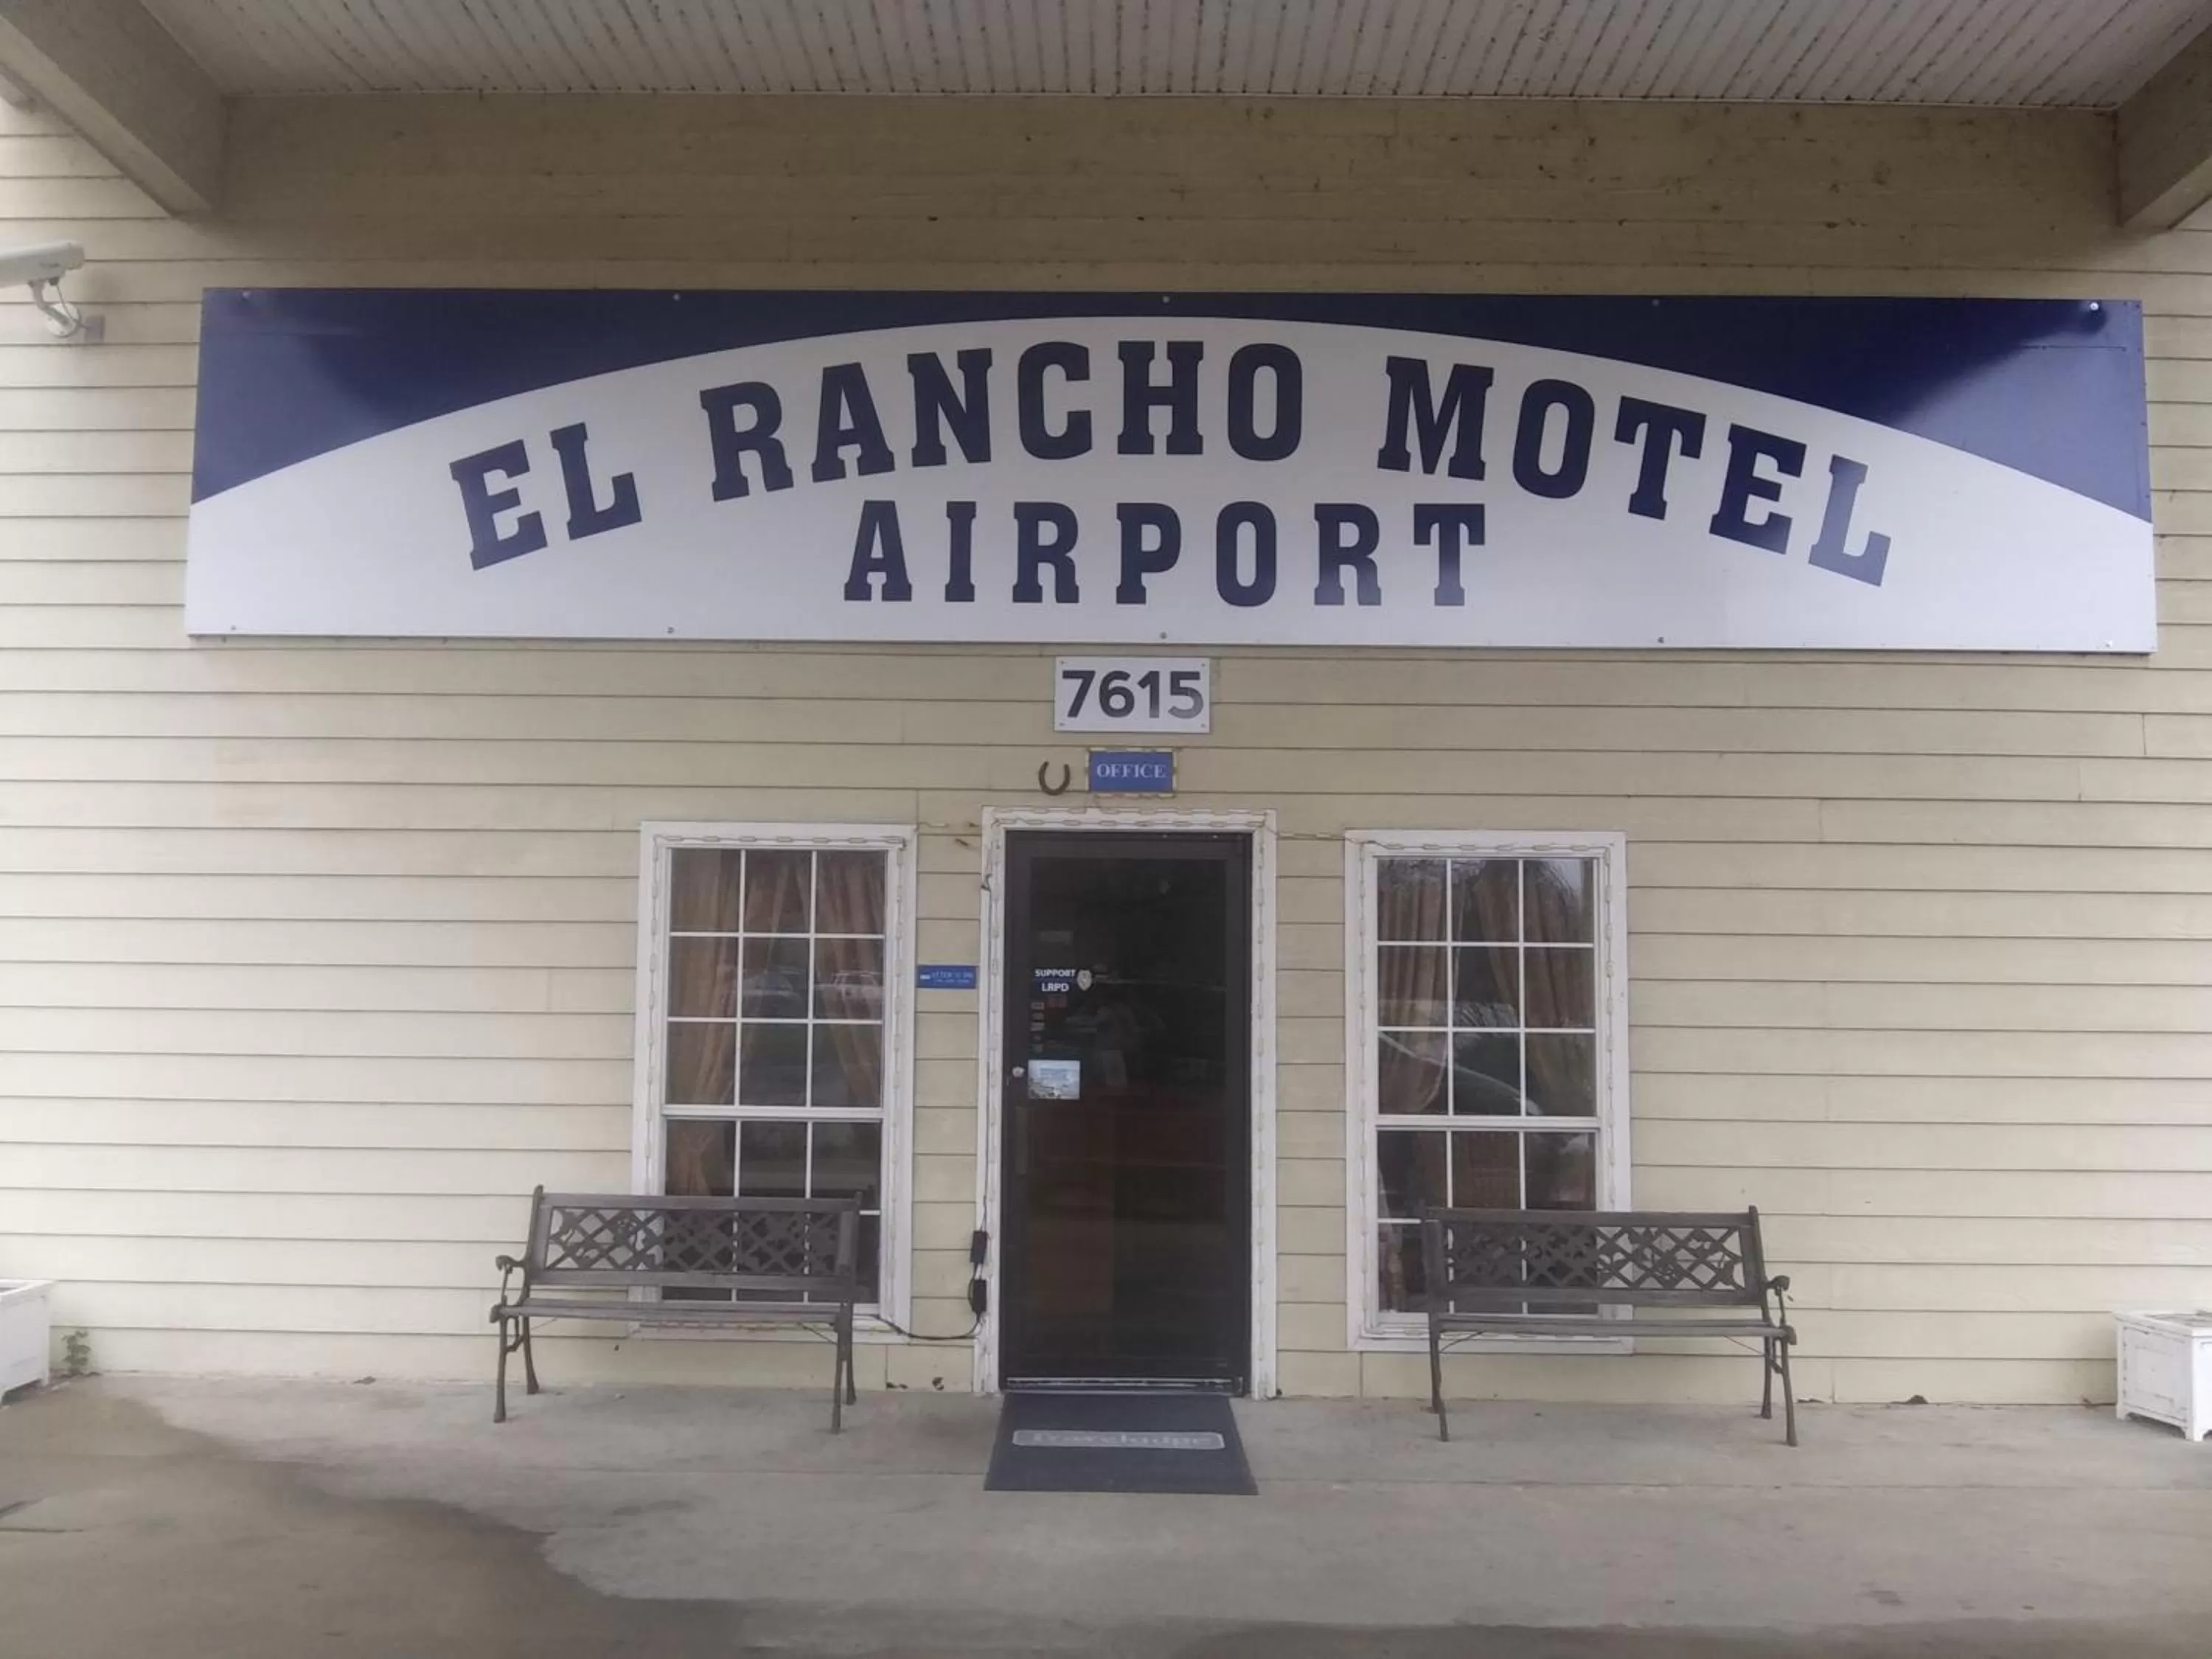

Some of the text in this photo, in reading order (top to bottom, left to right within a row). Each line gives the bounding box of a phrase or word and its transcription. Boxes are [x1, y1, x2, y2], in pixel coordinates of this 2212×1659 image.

[449, 339, 1891, 587] EL RANCHO MOTEL
[844, 500, 1486, 608] AIRPORT
[1062, 669, 1204, 719] 7615
[1096, 762, 1167, 779] OFFICE
[1034, 968, 1076, 978] SUPPORT
[1041, 981, 1069, 992] LRPD
